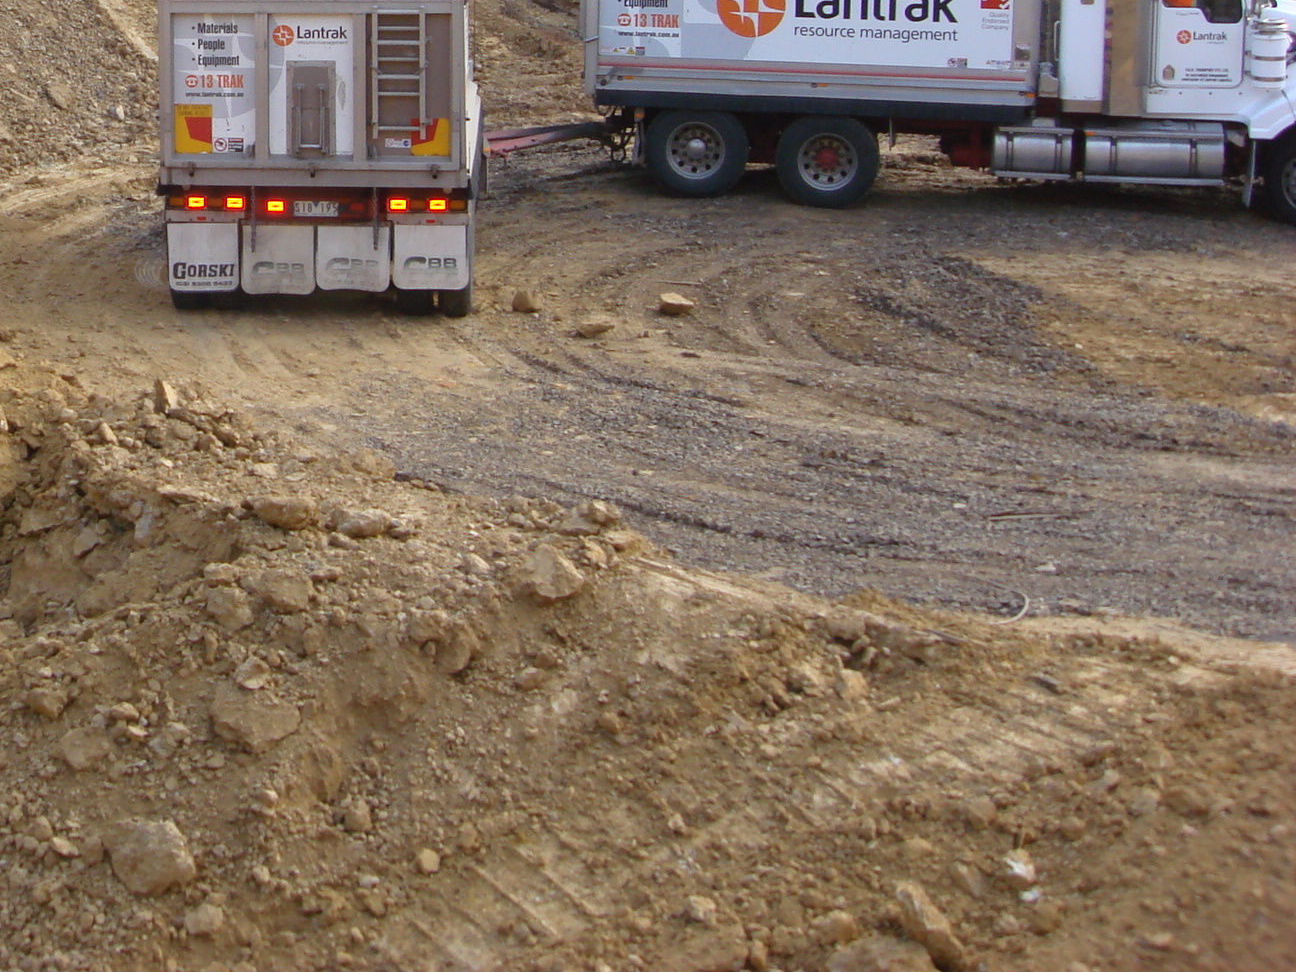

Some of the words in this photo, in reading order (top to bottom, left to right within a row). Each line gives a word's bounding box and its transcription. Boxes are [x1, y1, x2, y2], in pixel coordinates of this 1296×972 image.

[634, 13, 648, 28] 13
[651, 13, 680, 29] TRAK
[988, 11, 1010, 19] Quality
[197, 22, 239, 34] Materials
[296, 25, 348, 39] Lantrak
[794, 25, 856, 38] resource
[859, 26, 959, 43] management
[1193, 31, 1228, 40] Lantrak
[197, 38, 226, 51] People
[197, 54, 240, 67] Equipment
[200, 74, 214, 89] 13
[216, 74, 244, 89] TRAK
[172, 262, 236, 280] GORSKI
